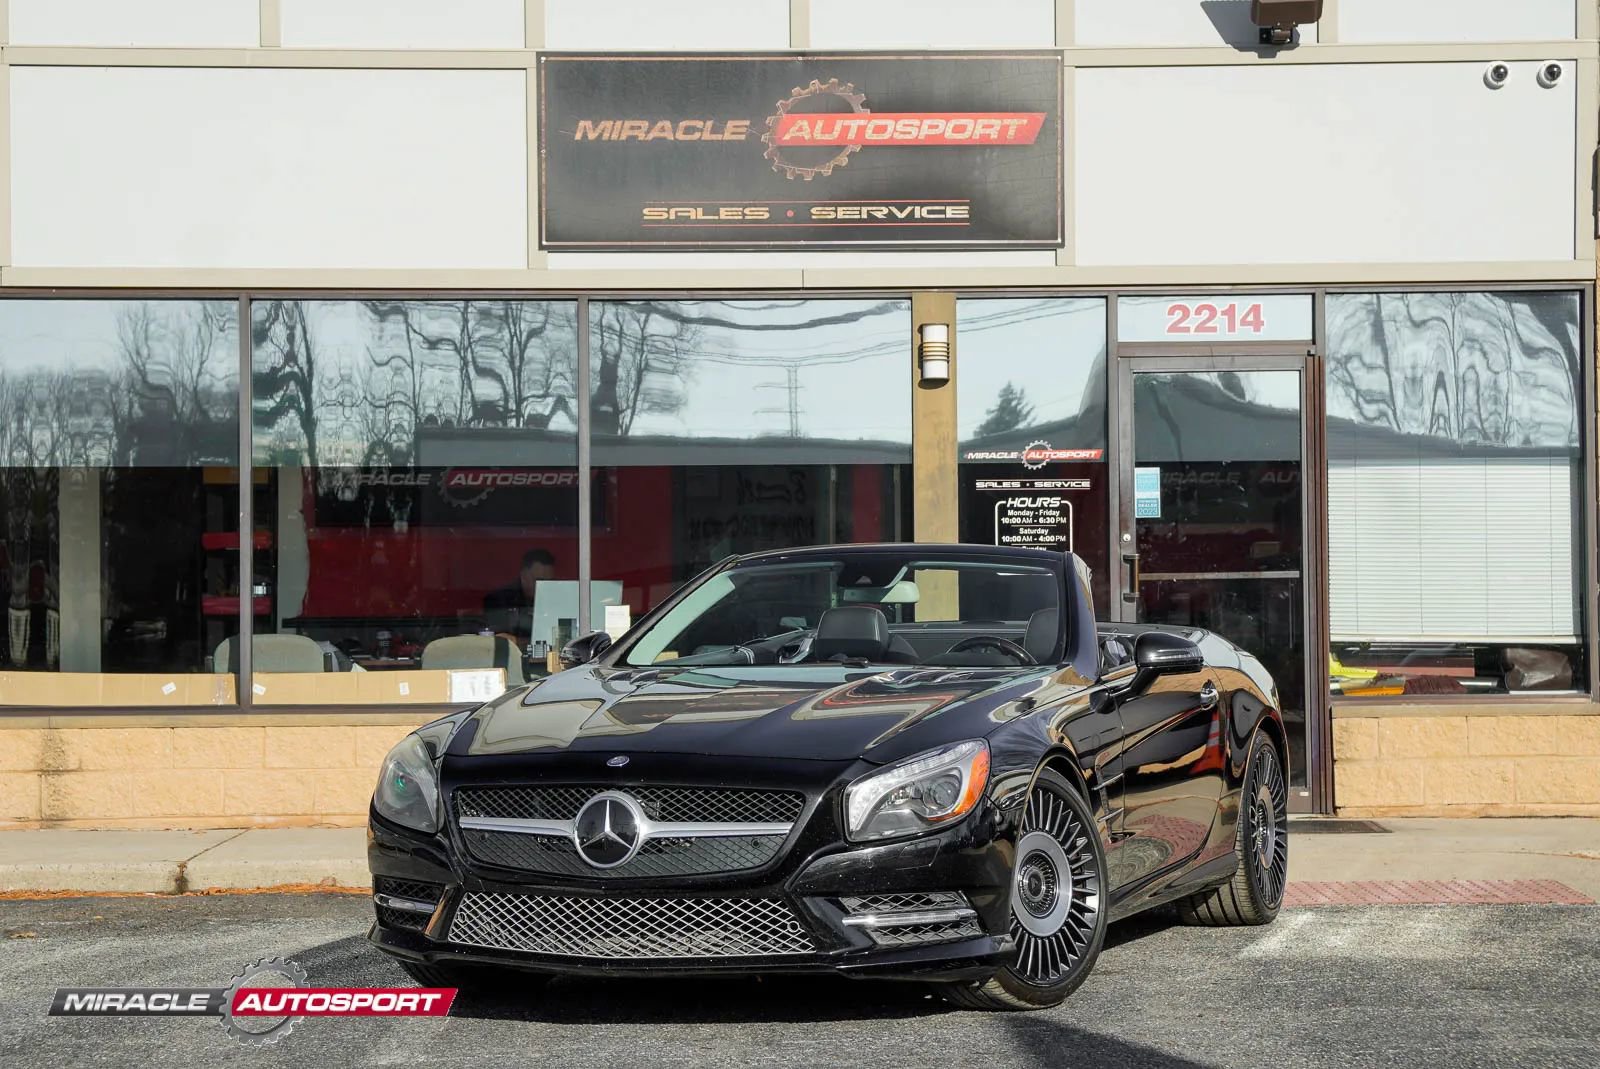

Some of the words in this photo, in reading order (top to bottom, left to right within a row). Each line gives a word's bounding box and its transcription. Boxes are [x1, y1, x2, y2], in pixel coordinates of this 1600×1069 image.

[574, 119, 751, 141] MIRACLE
[782, 118, 1028, 141] AUTOSPORT
[642, 207, 770, 220] SALES
[810, 206, 970, 219] SERVICE
[1166, 303, 1265, 334] 2214
[967, 451, 1019, 460] MIRACLE
[1027, 450, 1098, 459] AUTOSPORT
[1162, 471, 1241, 483] IRACLE
[1006, 497, 1061, 508] HOURS
[1007, 509, 1034, 517] Monday
[1039, 509, 1060, 517] Friday
[1019, 528, 1049, 536] Saturday
